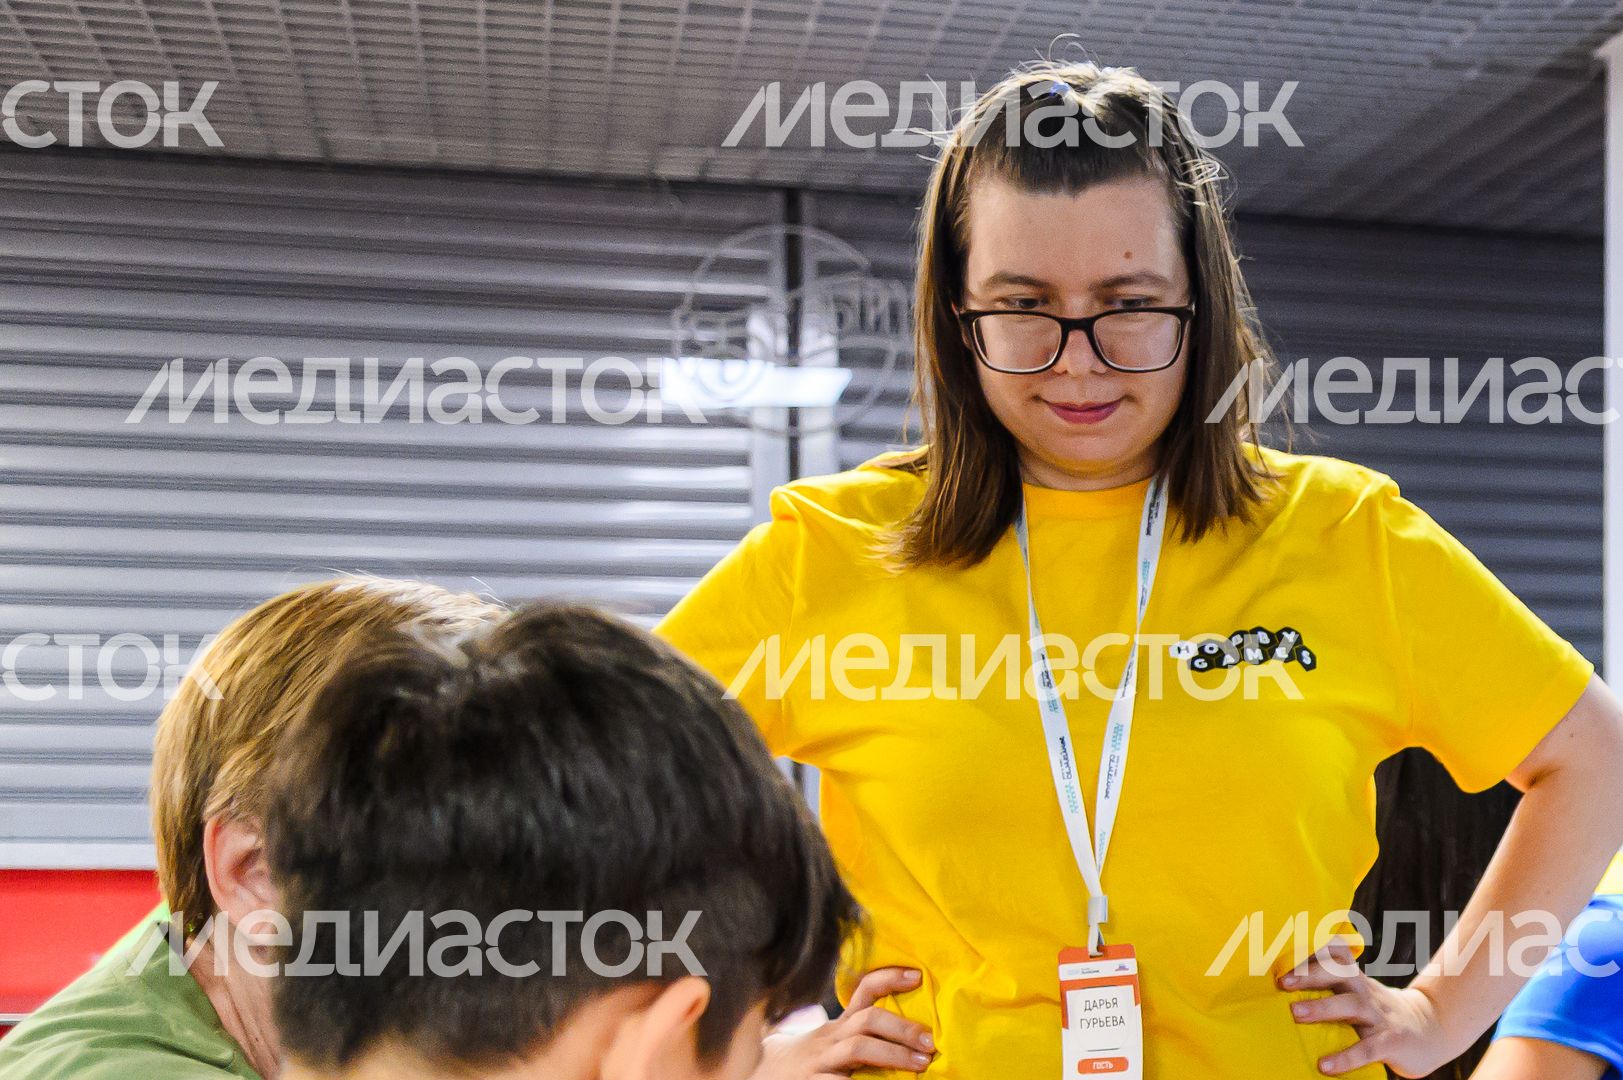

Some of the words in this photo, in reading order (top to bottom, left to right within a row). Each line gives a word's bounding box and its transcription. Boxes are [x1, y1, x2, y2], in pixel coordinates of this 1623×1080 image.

[1175, 630, 1298, 656] HOBBY
[1193, 646, 1313, 668] GAMES
[1084, 997, 1119, 1013] ДАРЬЯ
[1080, 1015, 1126, 1030] ГУРЬЕВА
